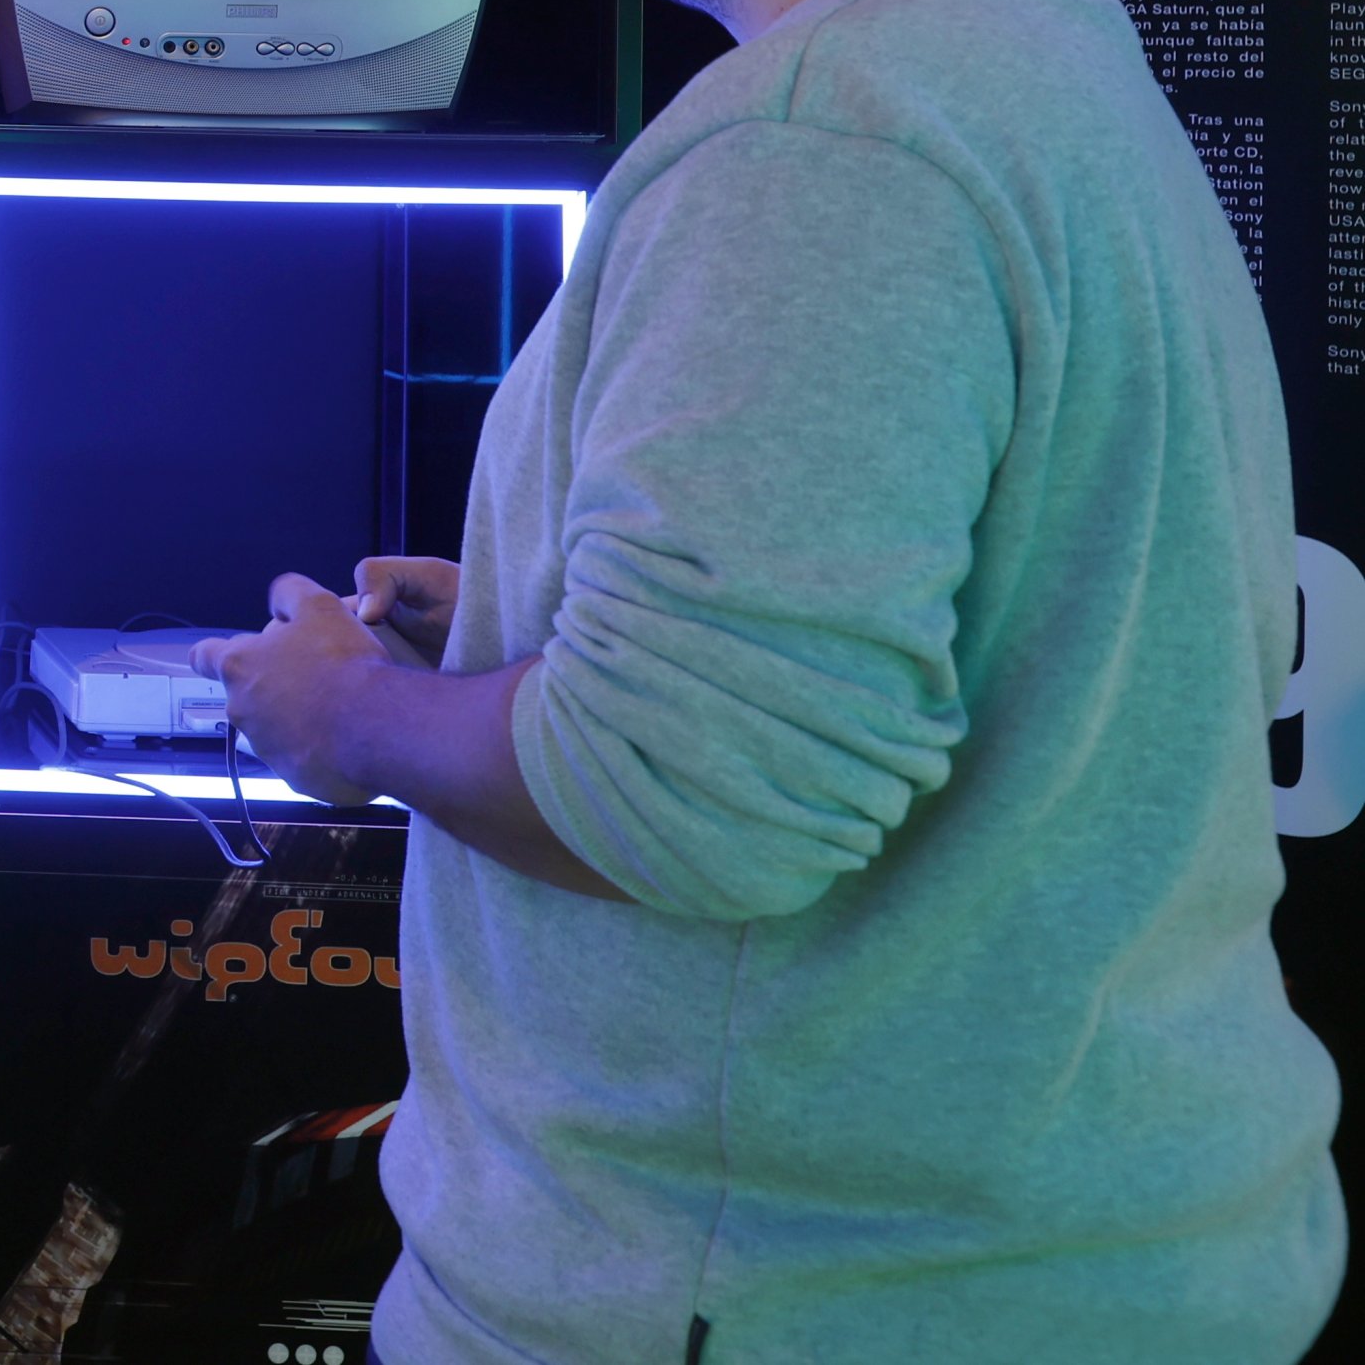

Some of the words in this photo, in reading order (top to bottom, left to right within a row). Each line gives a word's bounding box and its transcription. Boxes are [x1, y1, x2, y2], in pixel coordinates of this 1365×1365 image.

[1152, 3, 1210, 16] Saturn,
[1215, 5, 1245, 17] que
[1162, 21, 1180, 33] ya
[1190, 21, 1209, 31] se
[1219, 19, 1265, 31] había
[1206, 35, 1265, 47] faltaba
[1187, 113, 1223, 127] Tras
[1234, 117, 1264, 127] una
[1233, 146, 1264, 160] CD,
[1328, 182, 1363, 195] how
[1223, 209, 1264, 225] Sony
[1327, 313, 1363, 329] only
[1327, 362, 1361, 375] that
